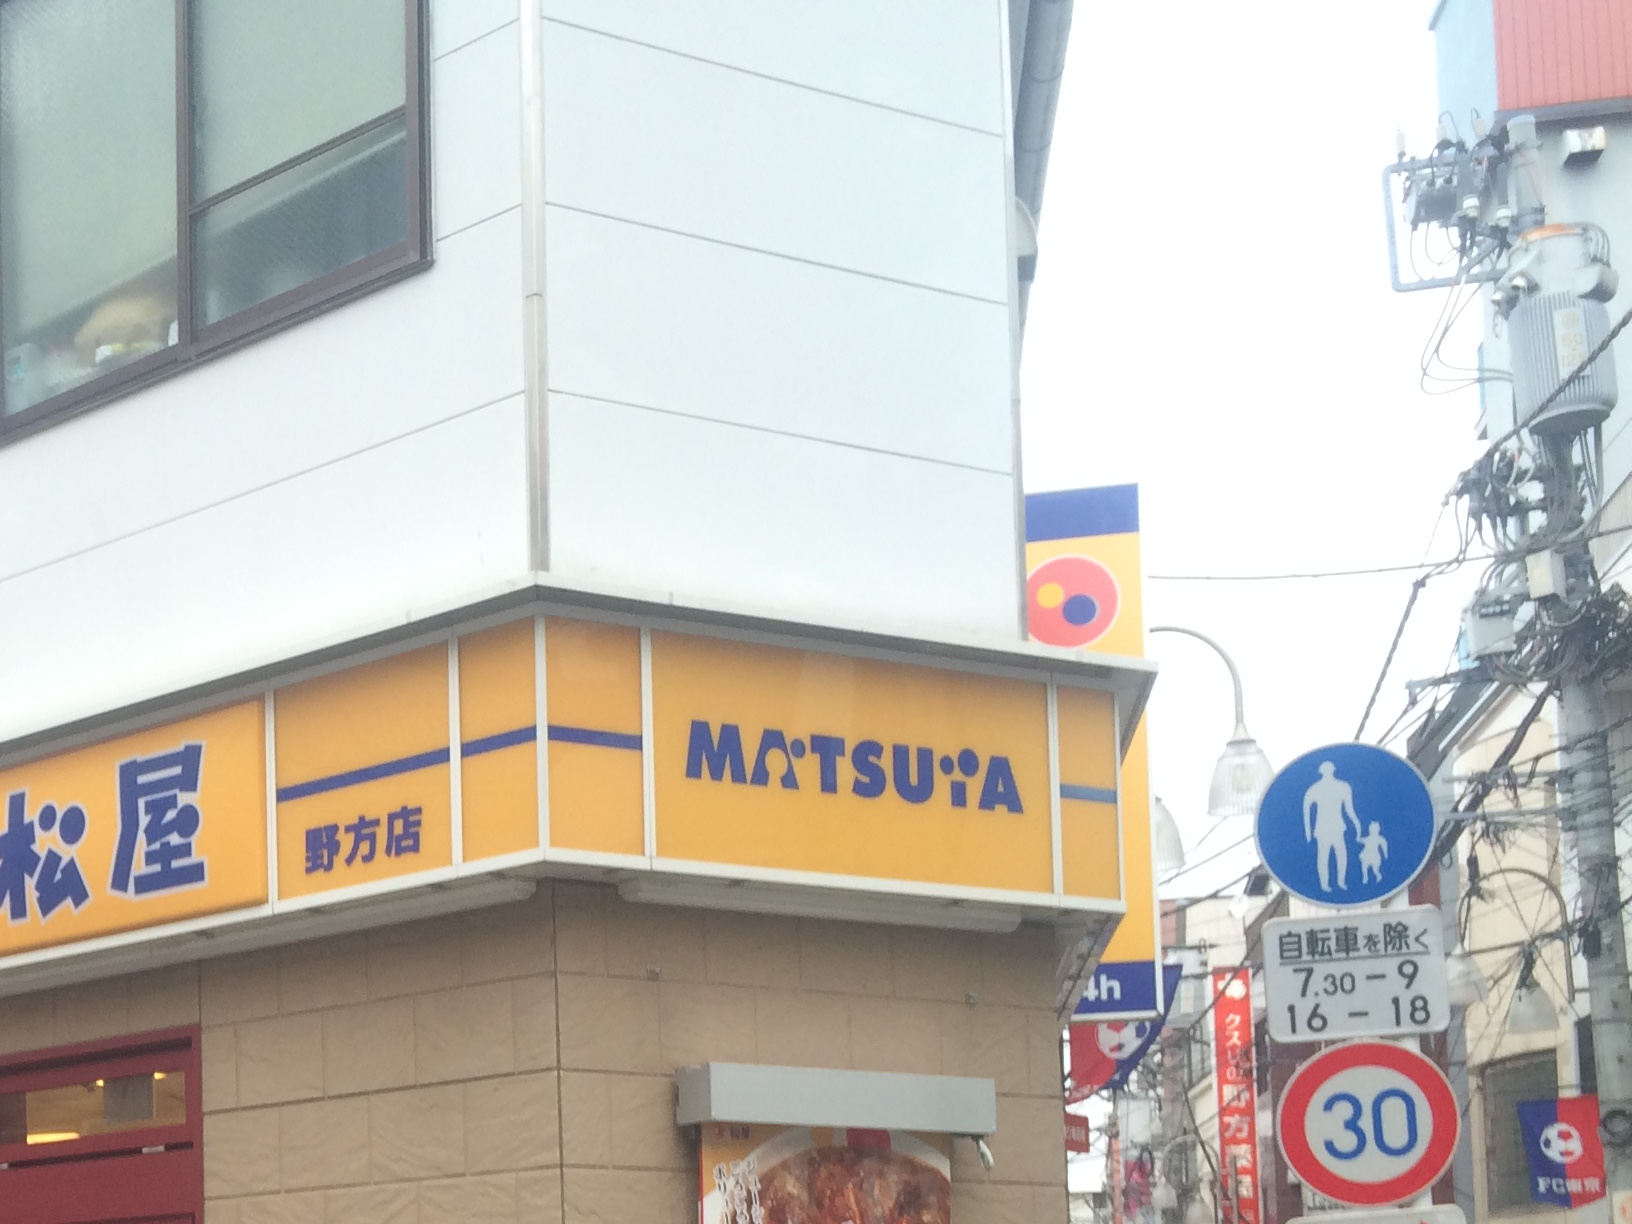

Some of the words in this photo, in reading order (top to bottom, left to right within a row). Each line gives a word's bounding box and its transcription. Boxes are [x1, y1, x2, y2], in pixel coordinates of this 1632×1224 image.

[685, 719, 1024, 814] MATSUYA
[304, 805, 423, 875] 野方店
[1278, 921, 1430, 961] 自転車を除く
[1082, 973, 1121, 1002] 4h
[1323, 1088, 1418, 1161] 30
